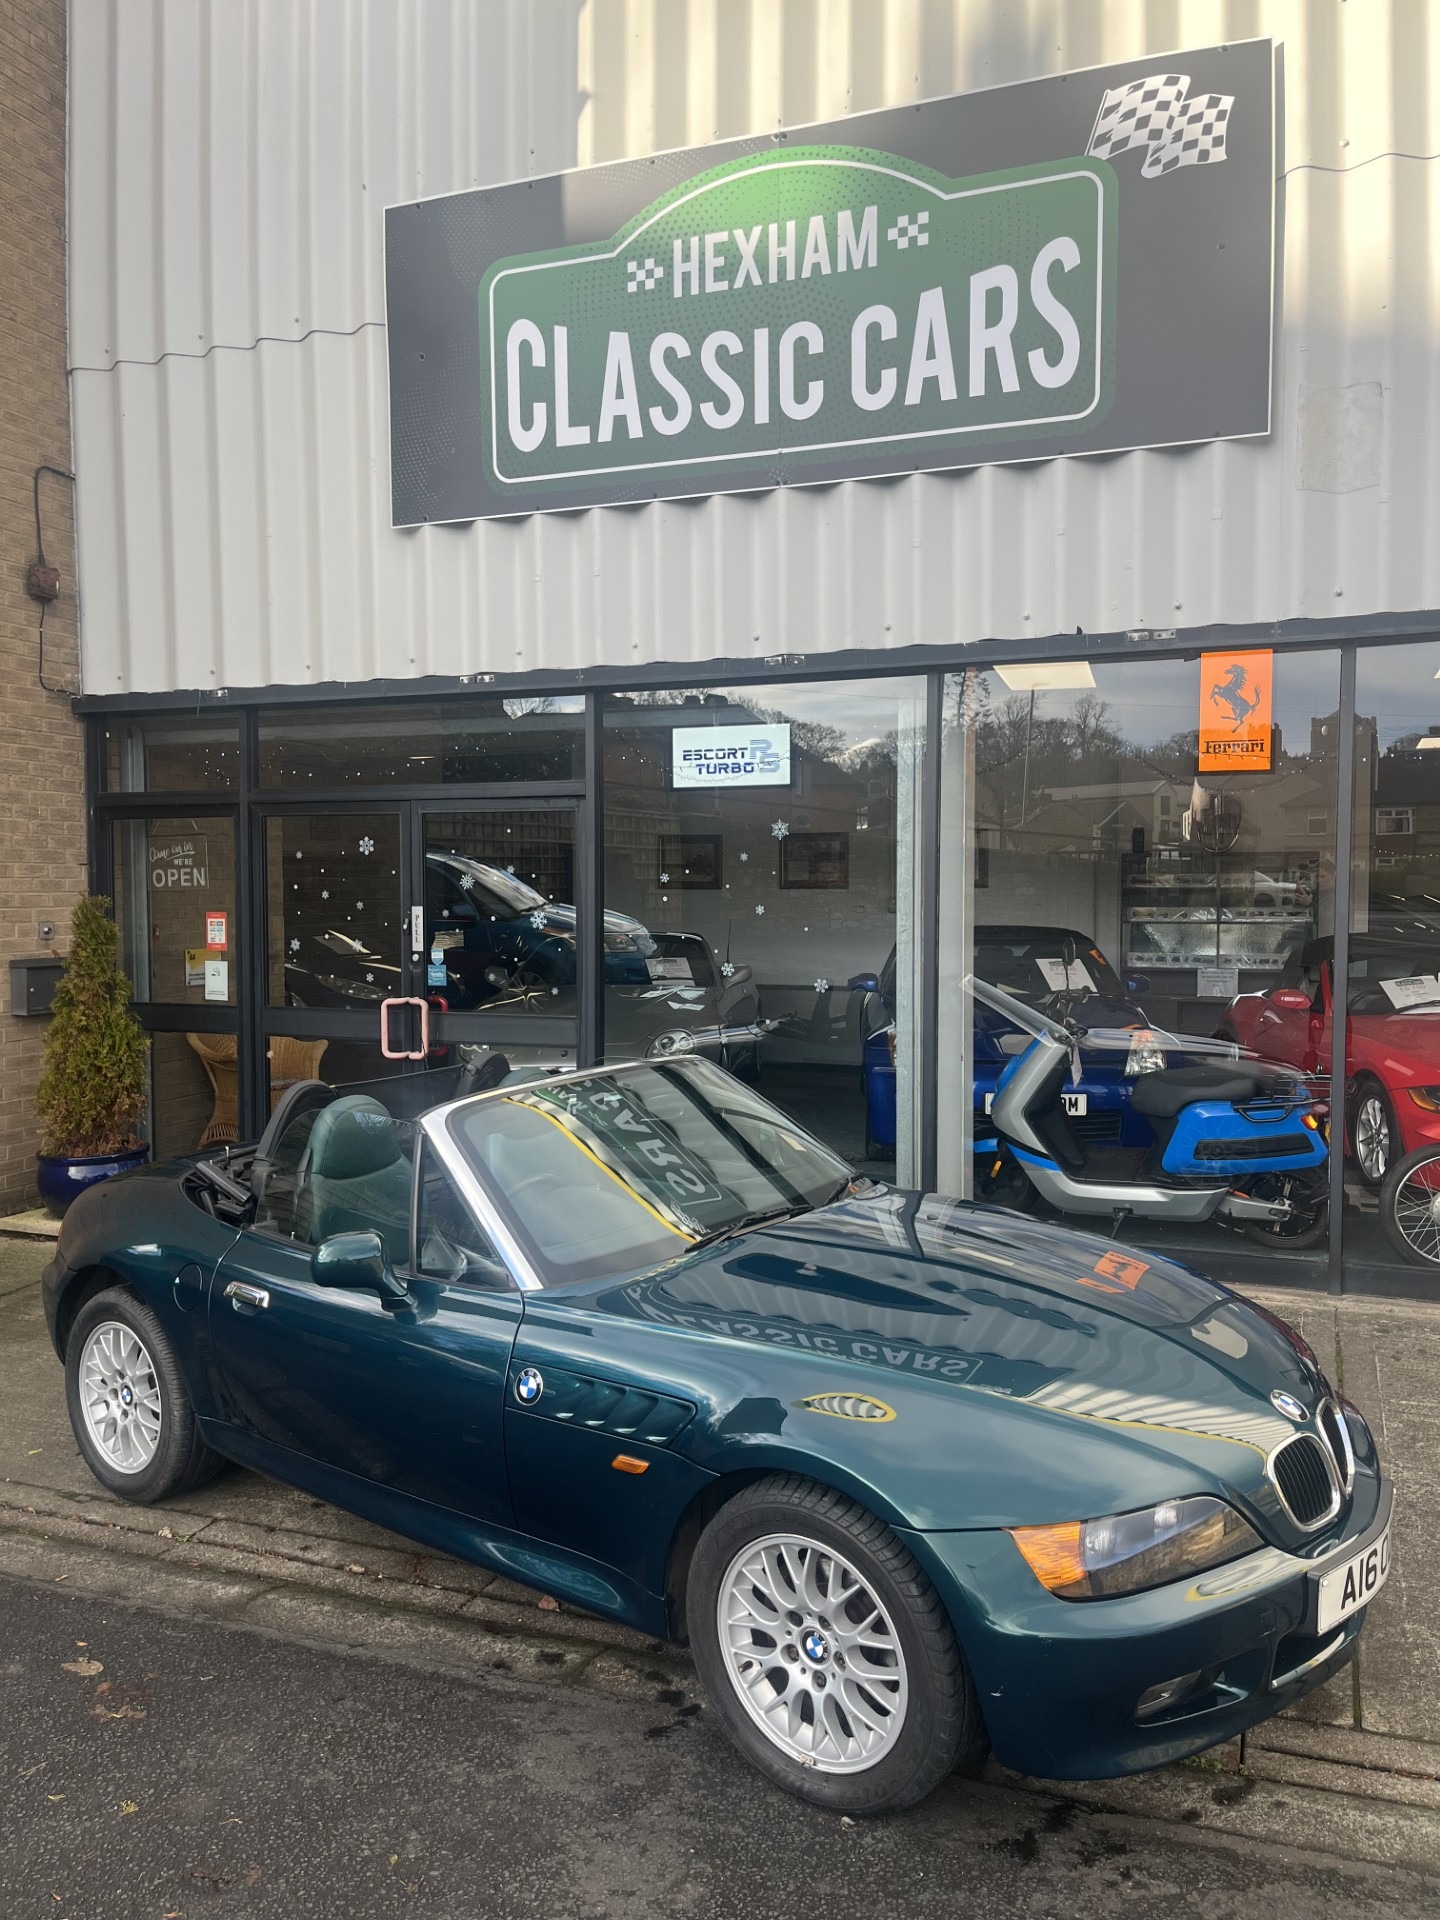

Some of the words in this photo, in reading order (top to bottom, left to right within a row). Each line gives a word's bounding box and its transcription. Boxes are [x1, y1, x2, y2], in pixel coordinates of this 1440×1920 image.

[673, 205, 879, 298] HEXHAM
[505, 318, 825, 453] CLASSIC
[850, 236, 1082, 411] CARS
[683, 747, 748, 761] ESCORT
[1204, 739, 1265, 754] Ferrari
[696, 762, 755, 775] TURBO
[173, 858, 193, 866] WE'RE
[152, 867, 206, 888] OPEN
[1341, 1547, 1378, 1610] A16
